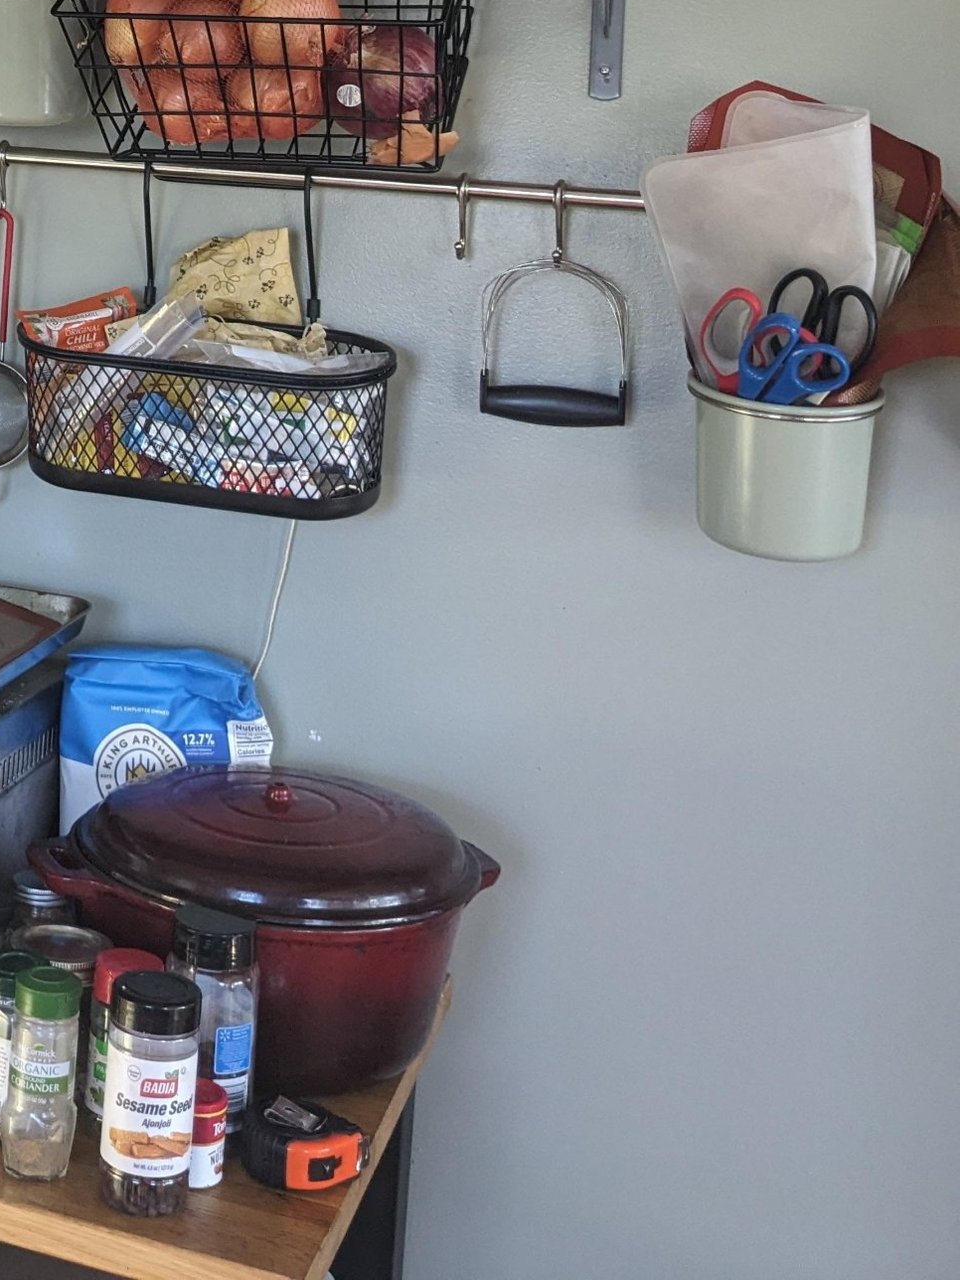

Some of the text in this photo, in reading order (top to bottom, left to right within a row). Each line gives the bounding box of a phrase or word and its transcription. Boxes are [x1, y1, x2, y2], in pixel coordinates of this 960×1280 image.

[66, 332, 97, 345] CHILI
[183, 733, 216, 746] 12.7%
[103, 738, 129, 770] KING
[12, 1057, 61, 1076] ORGANIC
[142, 1081, 177, 1094] BADIA
[115, 1092, 167, 1117] Sesame
